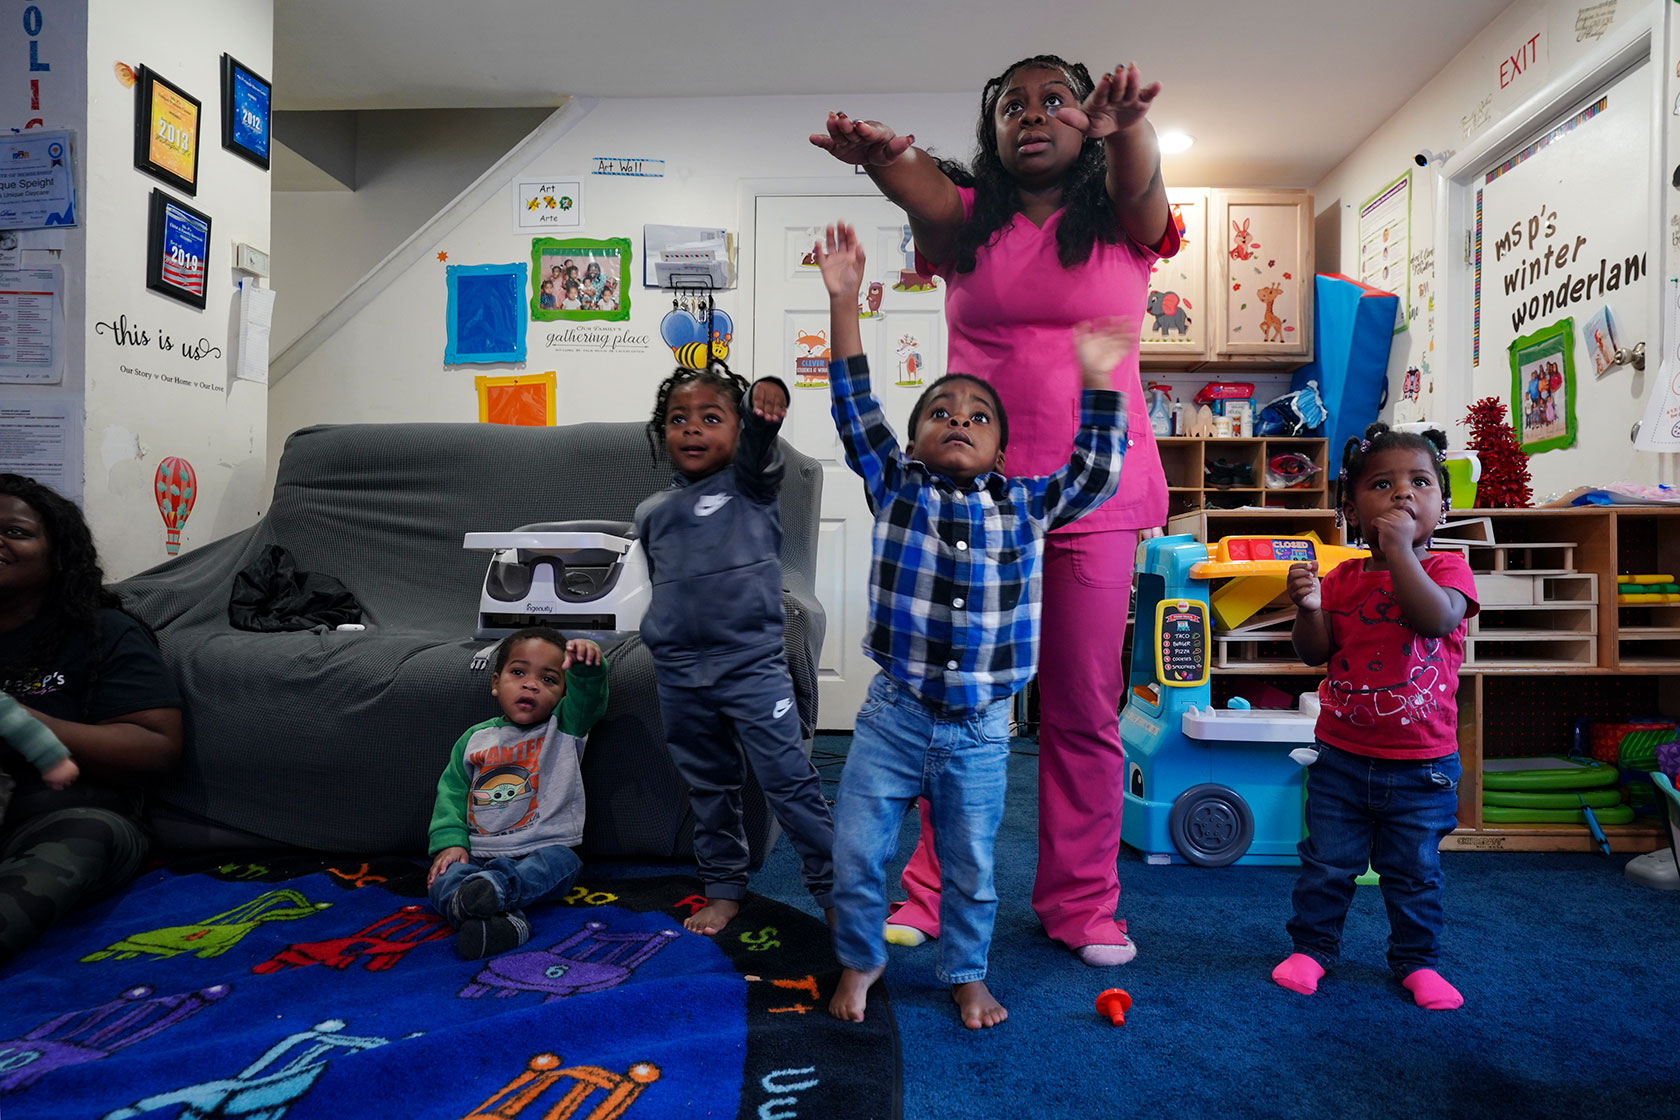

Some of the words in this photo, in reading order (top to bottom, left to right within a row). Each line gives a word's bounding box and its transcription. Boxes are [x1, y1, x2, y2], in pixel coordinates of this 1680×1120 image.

[23, 0, 50, 129] OLI
[1500, 33, 1540, 89] EXIT
[242, 108, 261, 130] 2012
[158, 119, 189, 151] 2013
[598, 160, 614, 171] Art
[619, 161, 642, 173] Wall
[18, 177, 54, 190] Speight
[539, 185, 556, 193] Art
[171, 245, 198, 271] 2019
[1504, 235, 1587, 296] winter
[95, 314, 151, 346] this
[159, 329, 174, 351] is
[182, 338, 221, 361] us
[545, 329, 610, 349] gathering
[612, 329, 650, 350] place
[120, 365, 133, 375] Our
[134, 368, 152, 380] Story
[161, 374, 173, 383] Our
[174, 377, 191, 386] Home
[199, 382, 211, 390] Our
[211, 383, 224, 393] Love
[1273, 541, 1309, 549] CLOSED
[1408, 699, 1439, 724] KITTY
[545, 964, 568, 979] 6
